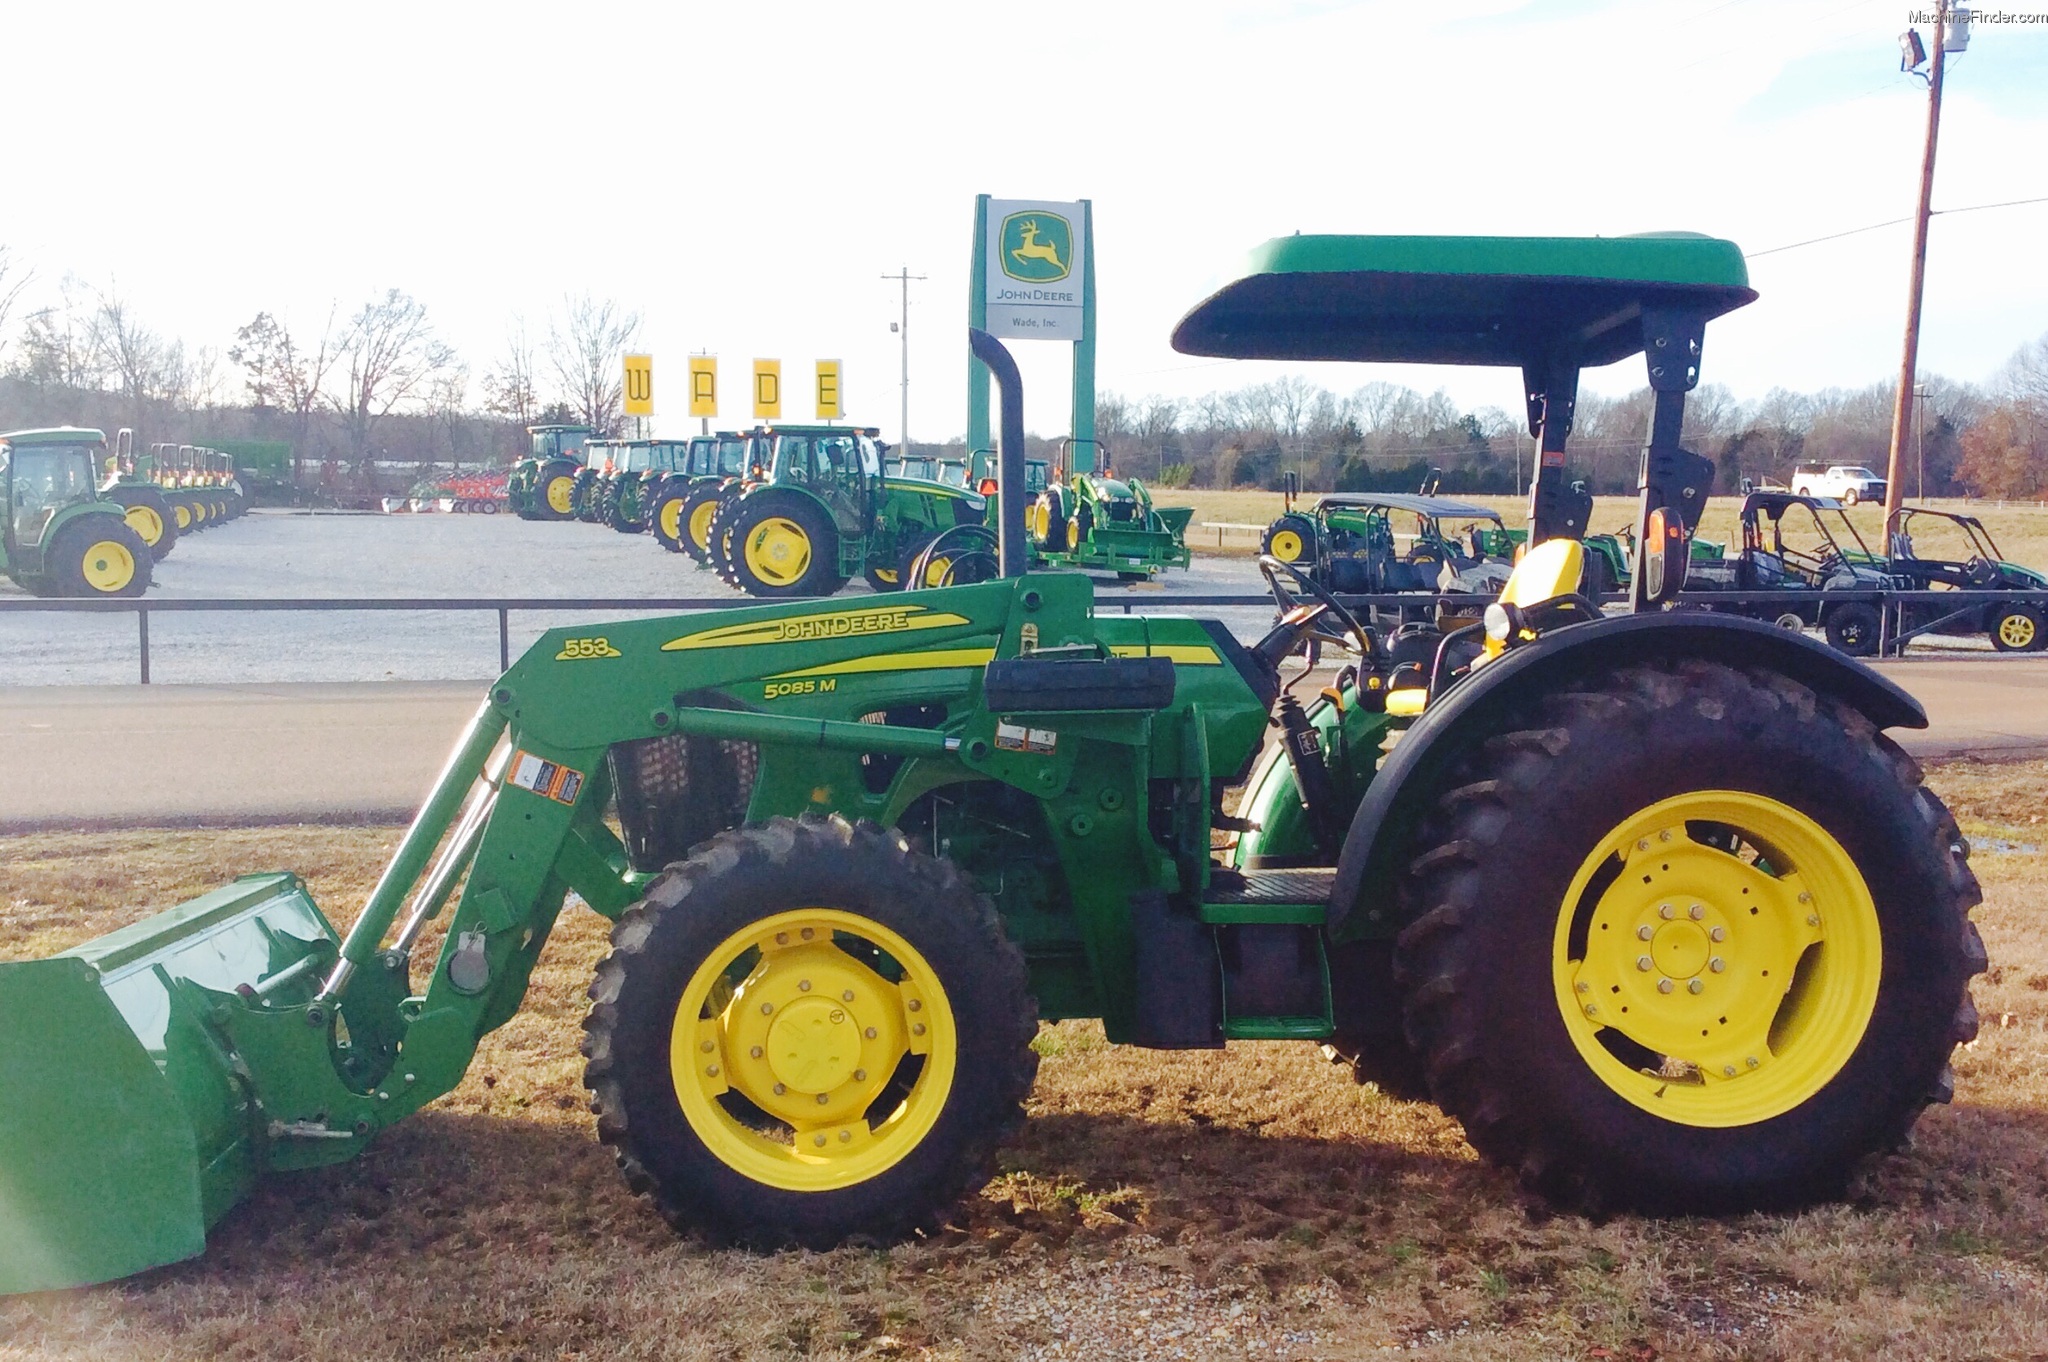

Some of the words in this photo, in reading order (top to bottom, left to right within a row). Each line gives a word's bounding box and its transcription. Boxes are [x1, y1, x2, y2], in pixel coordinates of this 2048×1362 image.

[996, 288, 1032, 300] JOHN
[1033, 289, 1074, 302] DEERE
[773, 620, 831, 641] JOHN
[831, 611, 909, 635] DEERE
[563, 637, 610, 657] 553
[763, 679, 817, 700] 5085
[818, 678, 838, 693] M
